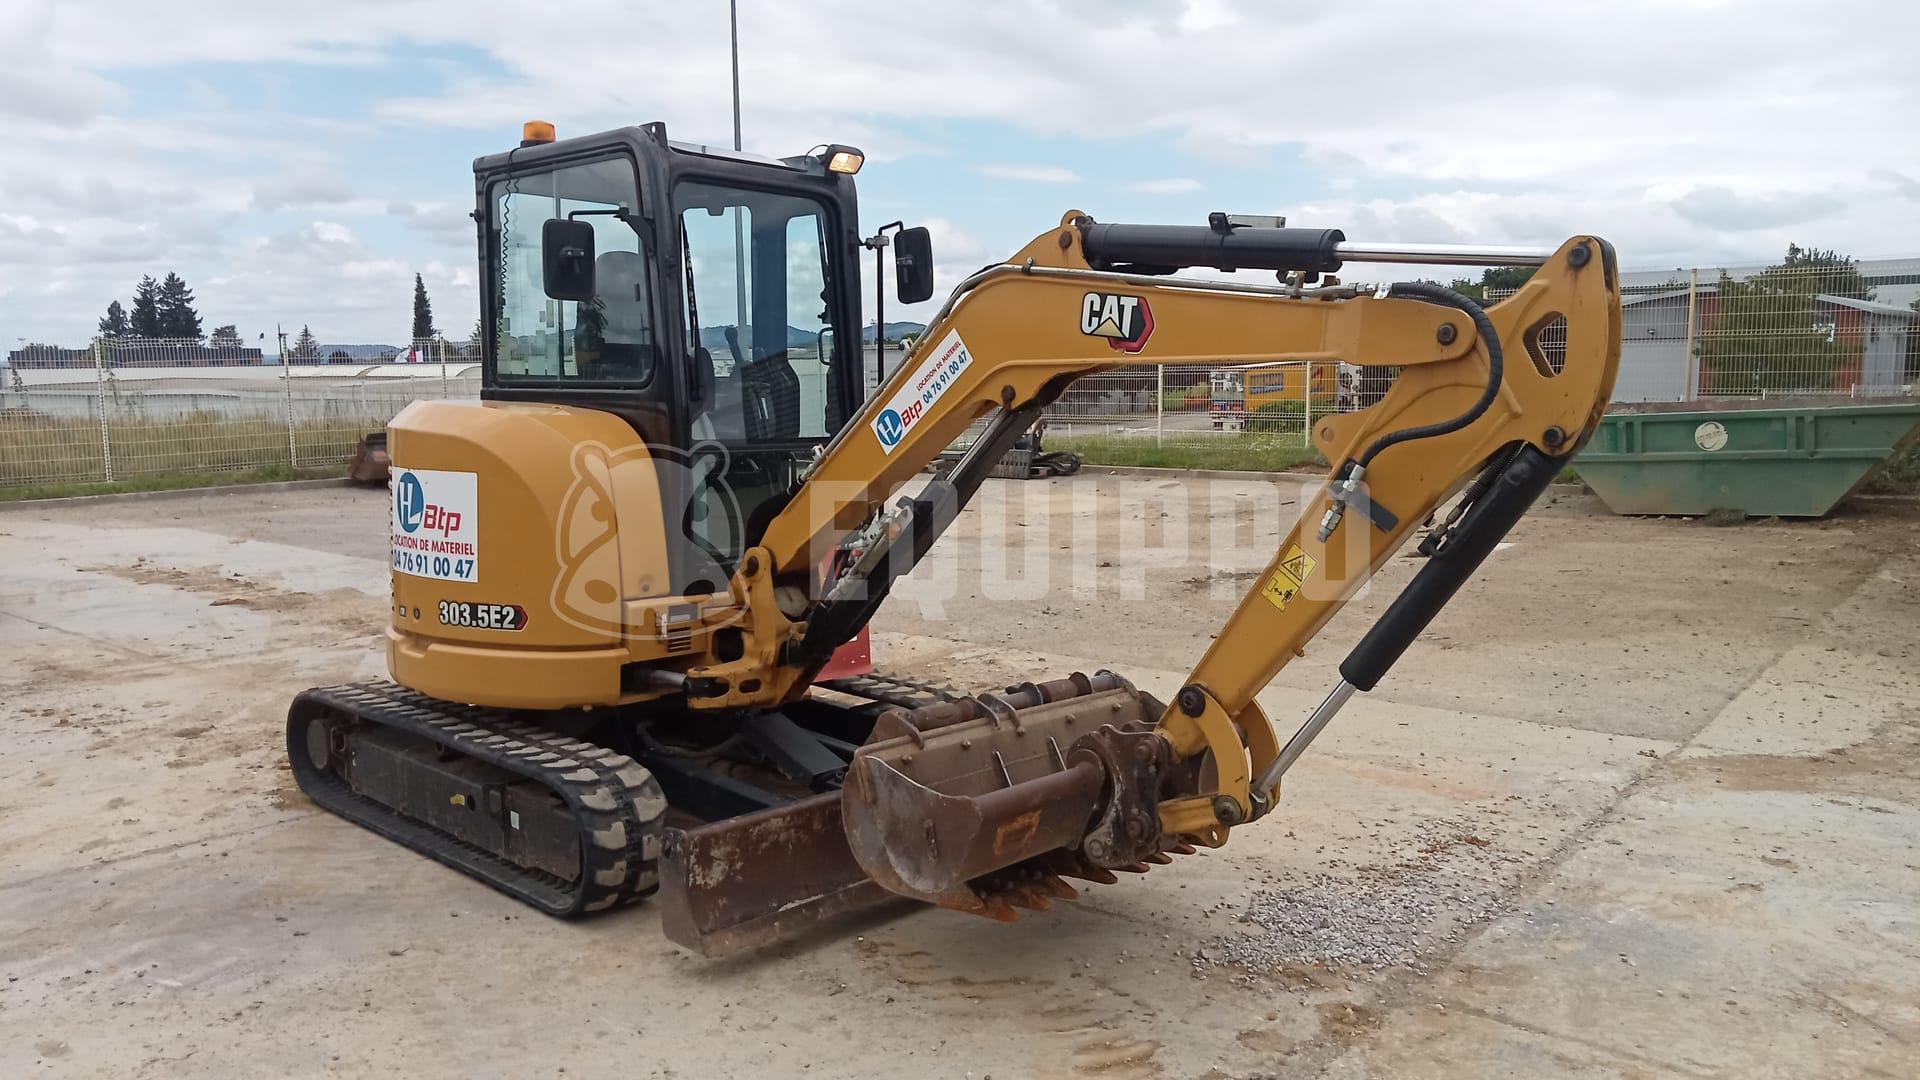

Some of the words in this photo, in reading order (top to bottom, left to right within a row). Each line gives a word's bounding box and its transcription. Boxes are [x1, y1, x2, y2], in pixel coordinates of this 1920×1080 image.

[1081, 292, 1138, 338] CAT
[916, 368, 938, 391] LOCATION
[941, 341, 961, 363] MATERIEL
[923, 391, 933, 404] 04
[931, 381, 942, 395] 76
[940, 371, 950, 384] 91
[949, 360, 960, 375] 00
[959, 350, 967, 364] 47
[901, 399, 923, 428] Btp
[423, 504, 461, 538] Btp
[420, 539, 429, 551] DE
[432, 540, 475, 556] MATERIEL
[394, 549, 401, 568] 04
[403, 552, 414, 571] 76
[416, 554, 428, 574] 91
[433, 556, 451, 577] 00
[454, 559, 474, 578] 47
[438, 600, 516, 629] 303.5E2
